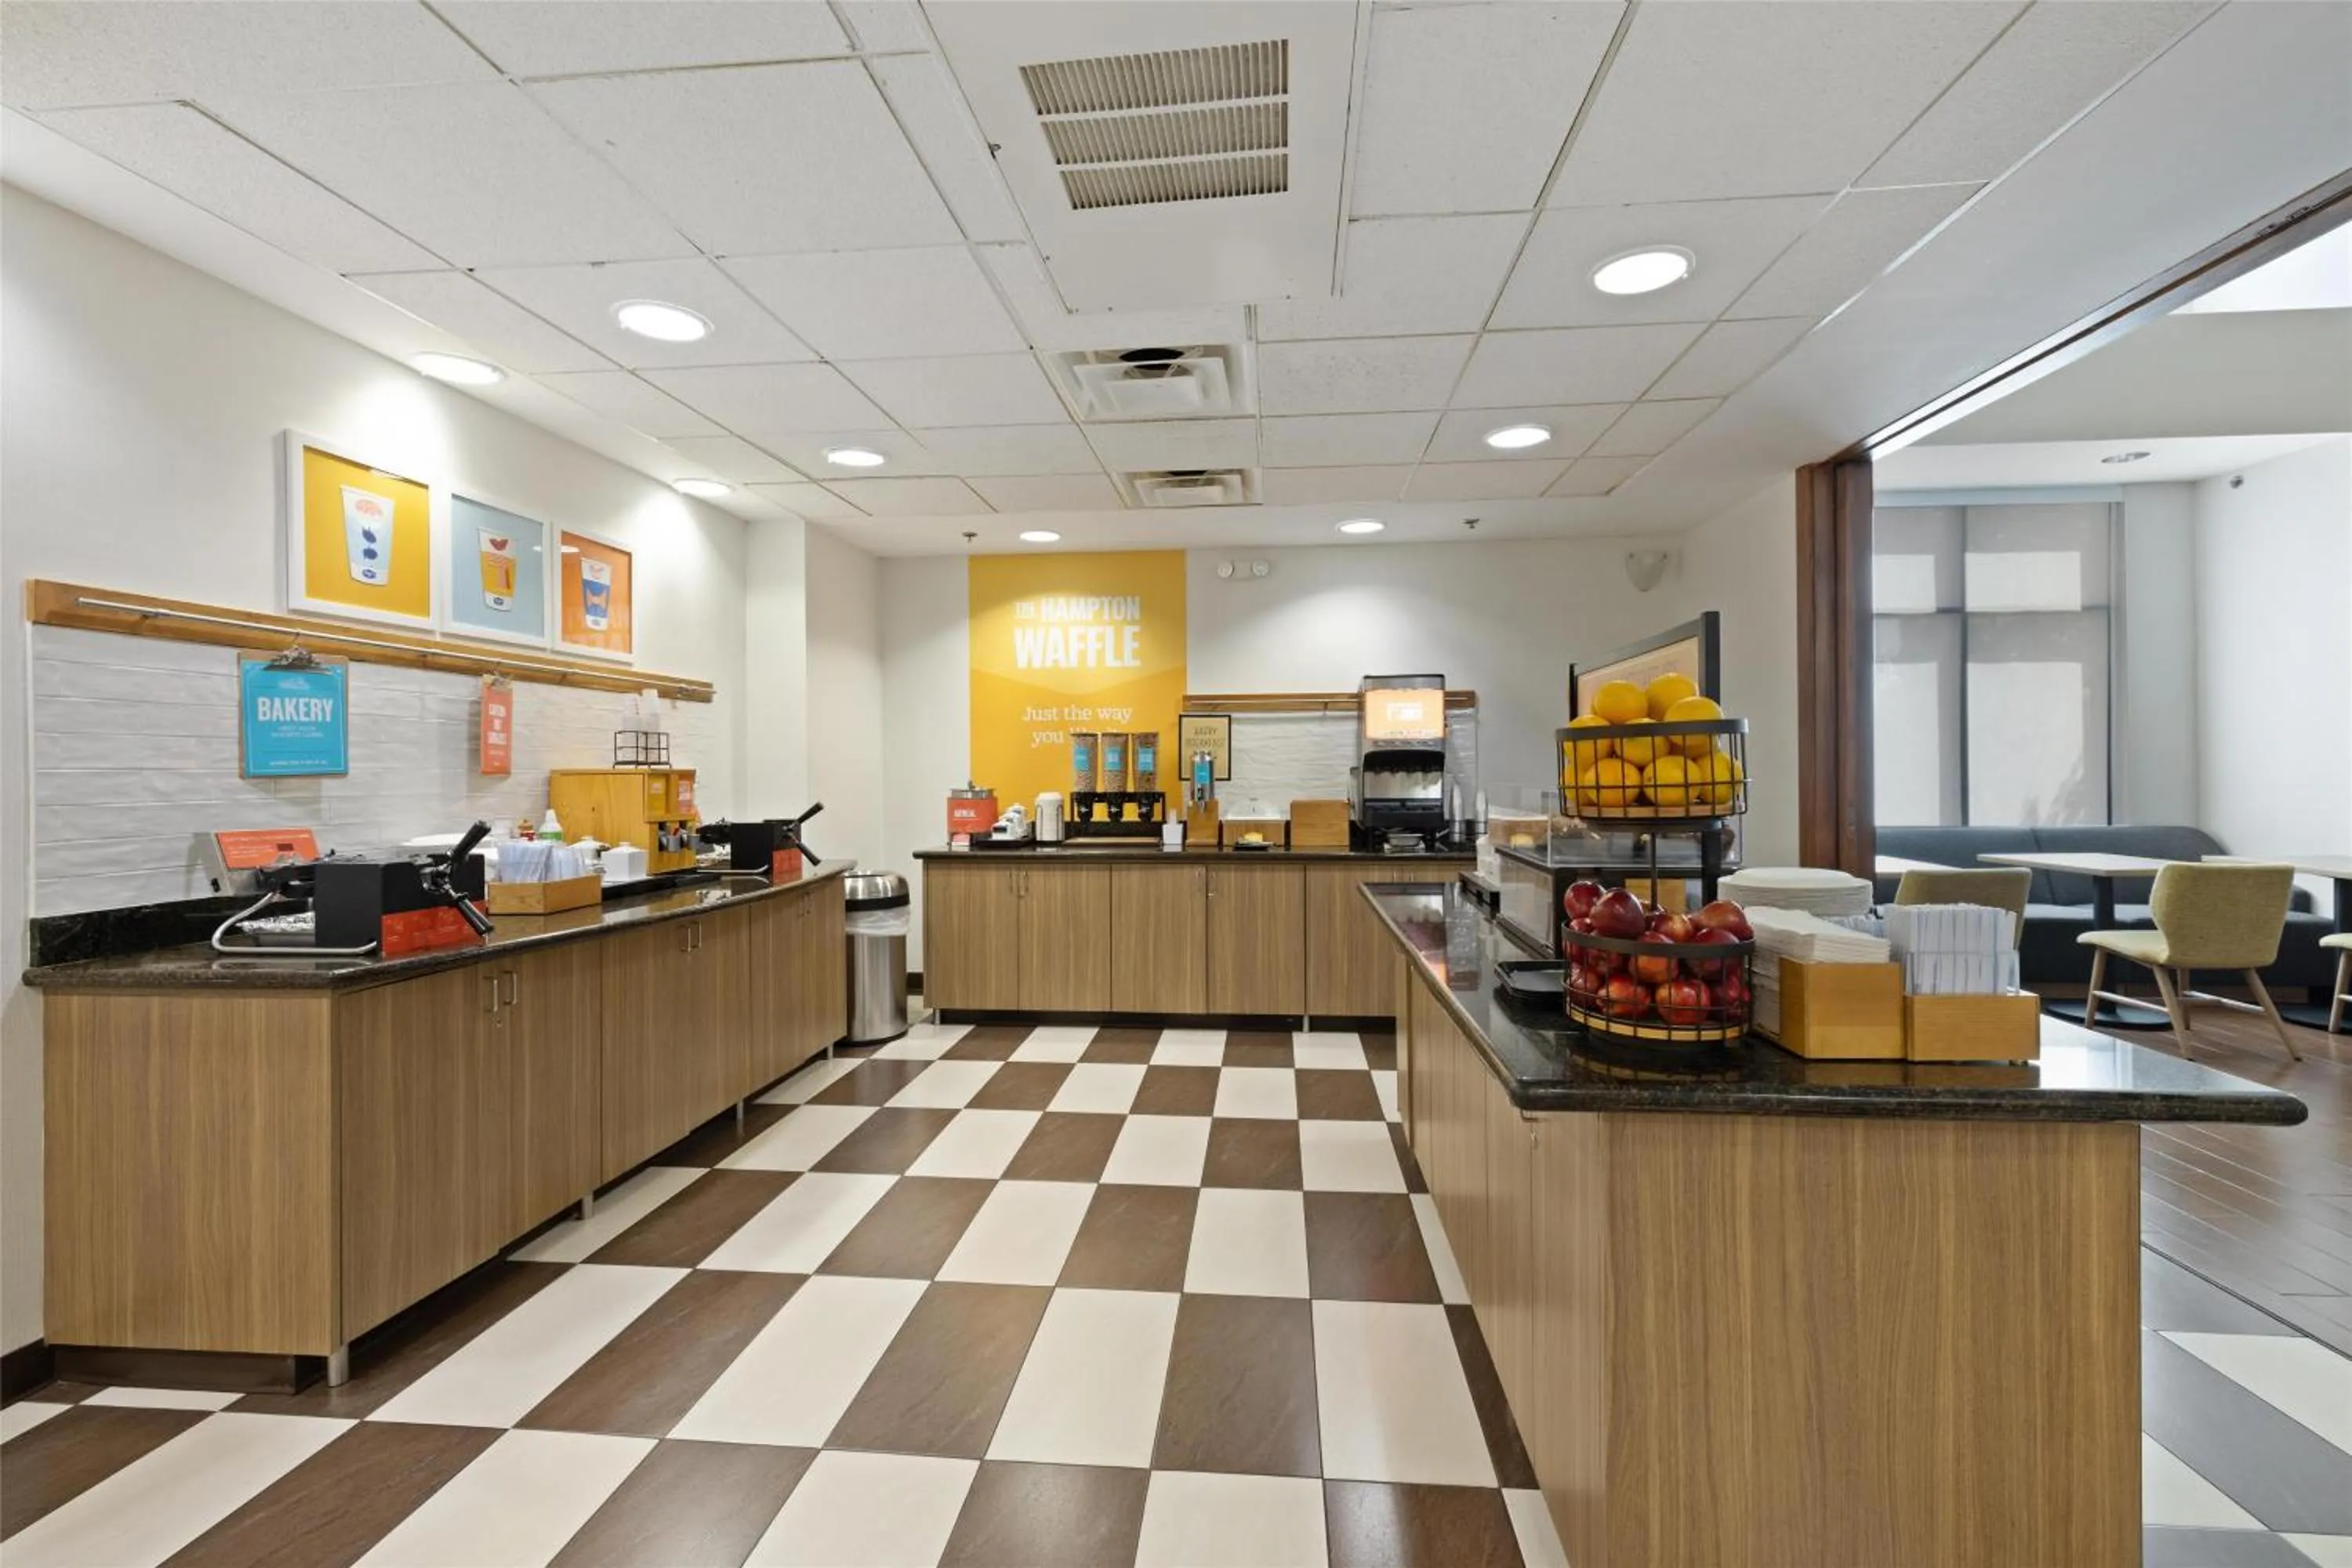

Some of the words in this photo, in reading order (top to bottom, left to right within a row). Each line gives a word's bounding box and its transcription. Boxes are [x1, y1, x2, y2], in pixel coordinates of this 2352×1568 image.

[1041, 596, 1141, 620] HAMPTON
[1014, 626, 1141, 669] WAFFLE
[256, 697, 333, 722] BAKERY
[1022, 706, 1058, 721] Just
[1064, 704, 1092, 720] the
[1098, 707, 1132, 724] way
[1031, 731, 1064, 748] you
